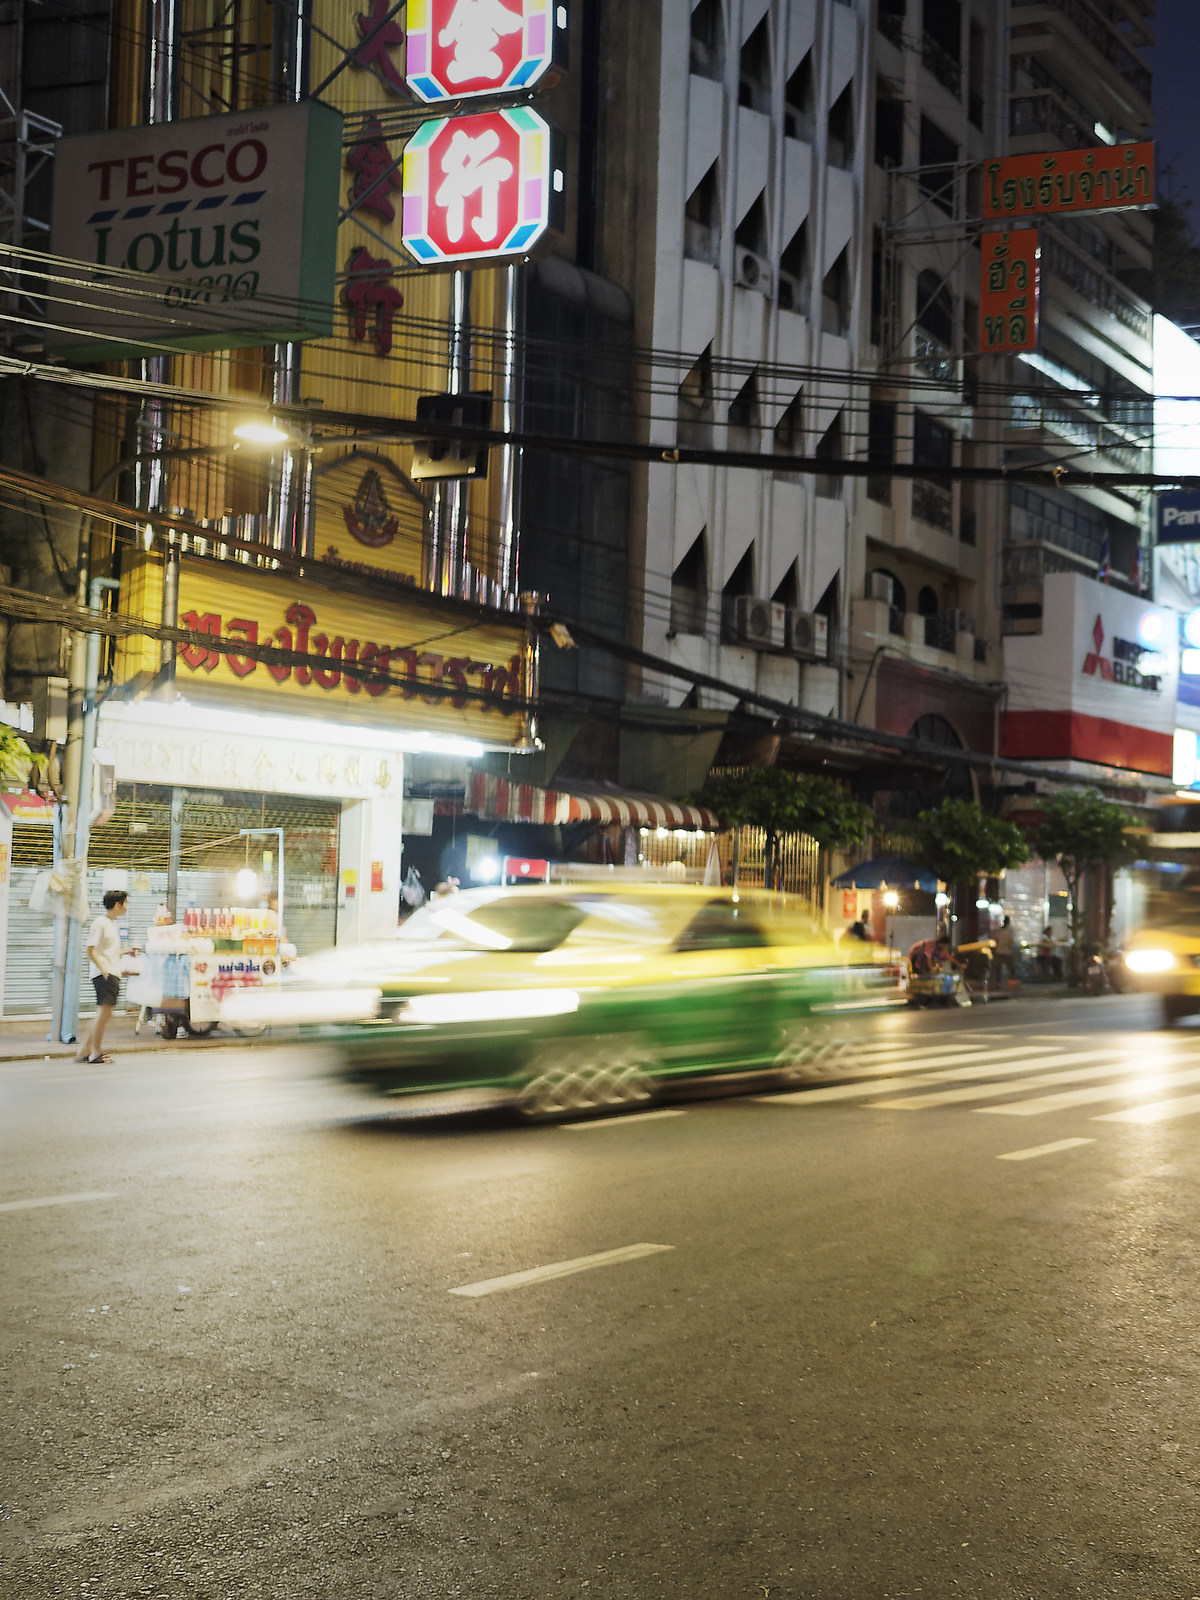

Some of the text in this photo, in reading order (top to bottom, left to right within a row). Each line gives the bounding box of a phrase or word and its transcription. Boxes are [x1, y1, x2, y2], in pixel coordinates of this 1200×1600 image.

[87, 139, 268, 201] TESCO
[987, 148, 1151, 211] โรงรับจำนำ
[91, 217, 261, 280] Lotus
